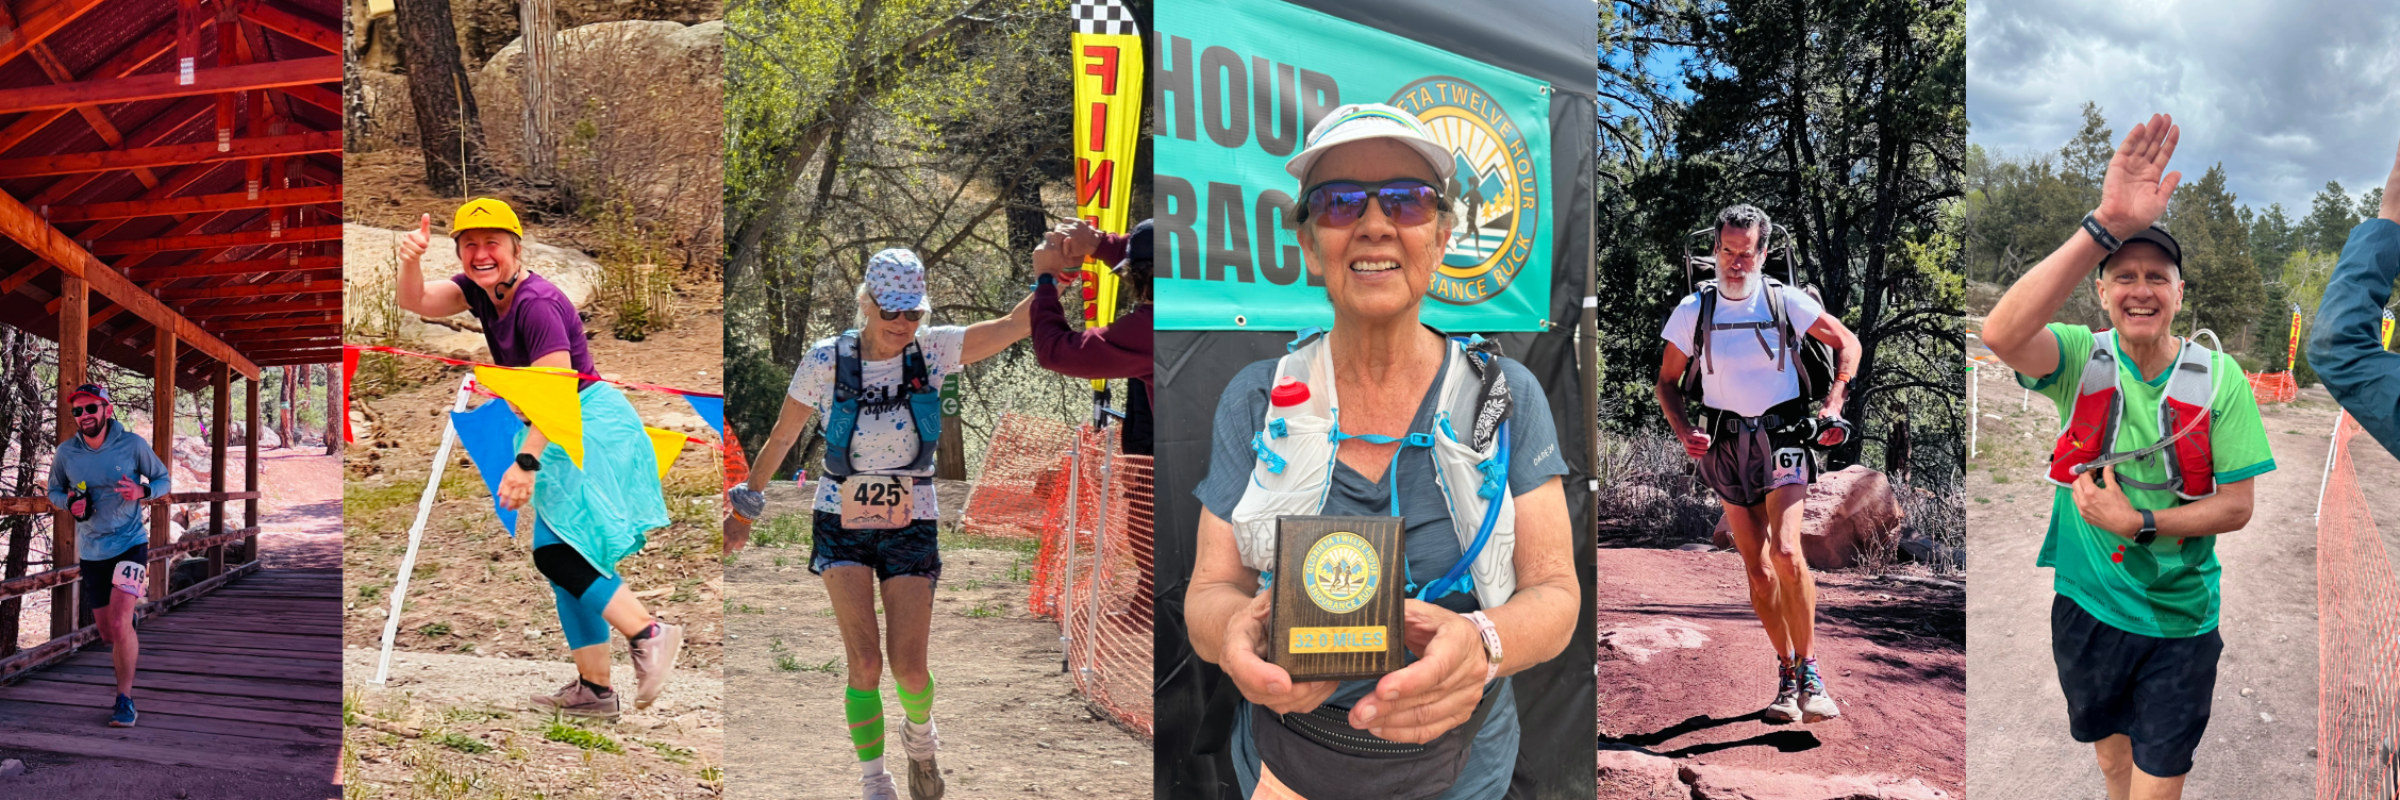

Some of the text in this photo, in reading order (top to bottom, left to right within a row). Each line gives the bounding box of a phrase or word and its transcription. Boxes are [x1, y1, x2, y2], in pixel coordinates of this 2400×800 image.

[1436, 83, 1535, 209] TWELVE HOUR
[1154, 173, 1327, 287] RAC
[1430, 232, 1531, 300] RANCE RUCK
[853, 483, 901, 507] 425
[1306, 535, 1377, 576] GLORIETA TWELVE HOUR
[121, 565, 145, 584] 419
[1309, 583, 1373, 610] ENDURANCE RUN
[1333, 632, 1384, 648] MILES
